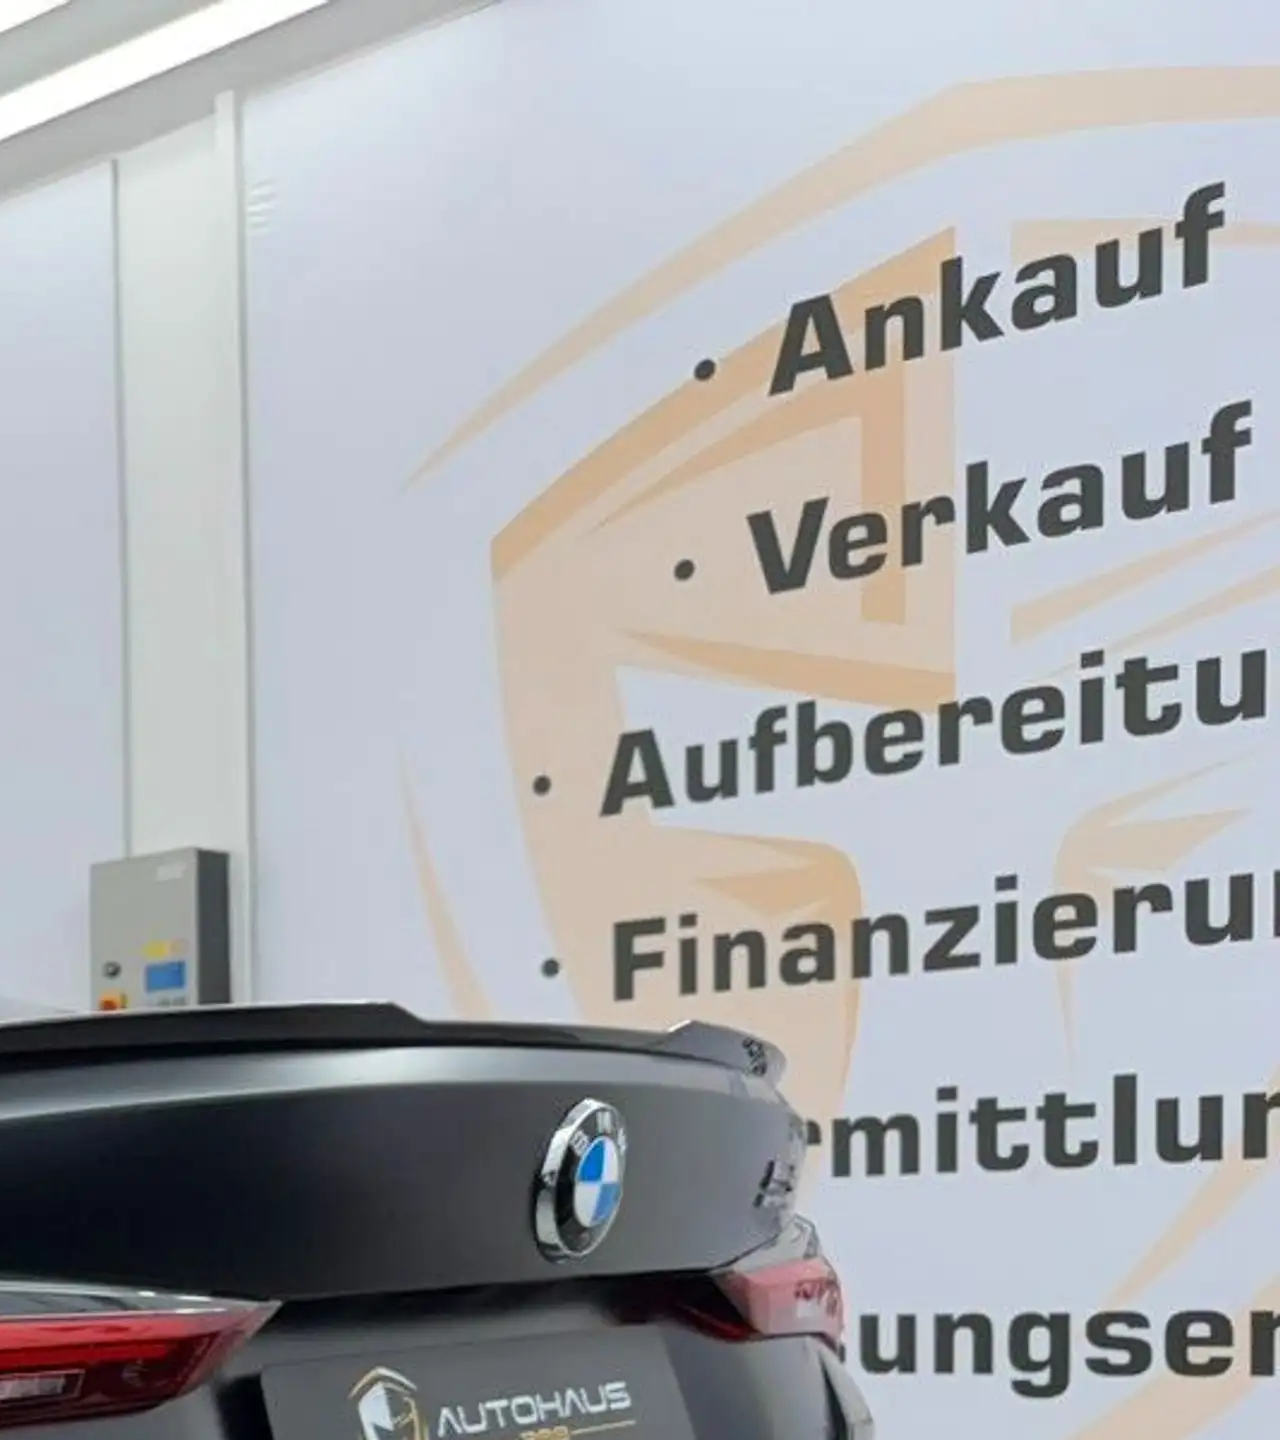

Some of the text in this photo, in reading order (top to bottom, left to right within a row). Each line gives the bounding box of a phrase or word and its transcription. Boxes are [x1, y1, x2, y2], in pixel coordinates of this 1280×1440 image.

[768, 181, 1226, 397] Ankauf
[746, 399, 1253, 595] Verkauf
[599, 648, 1267, 817] Aufbereitu
[613, 869, 1280, 1002] Finanzieru
[436, 1380, 633, 1438] AUTOHAUS
